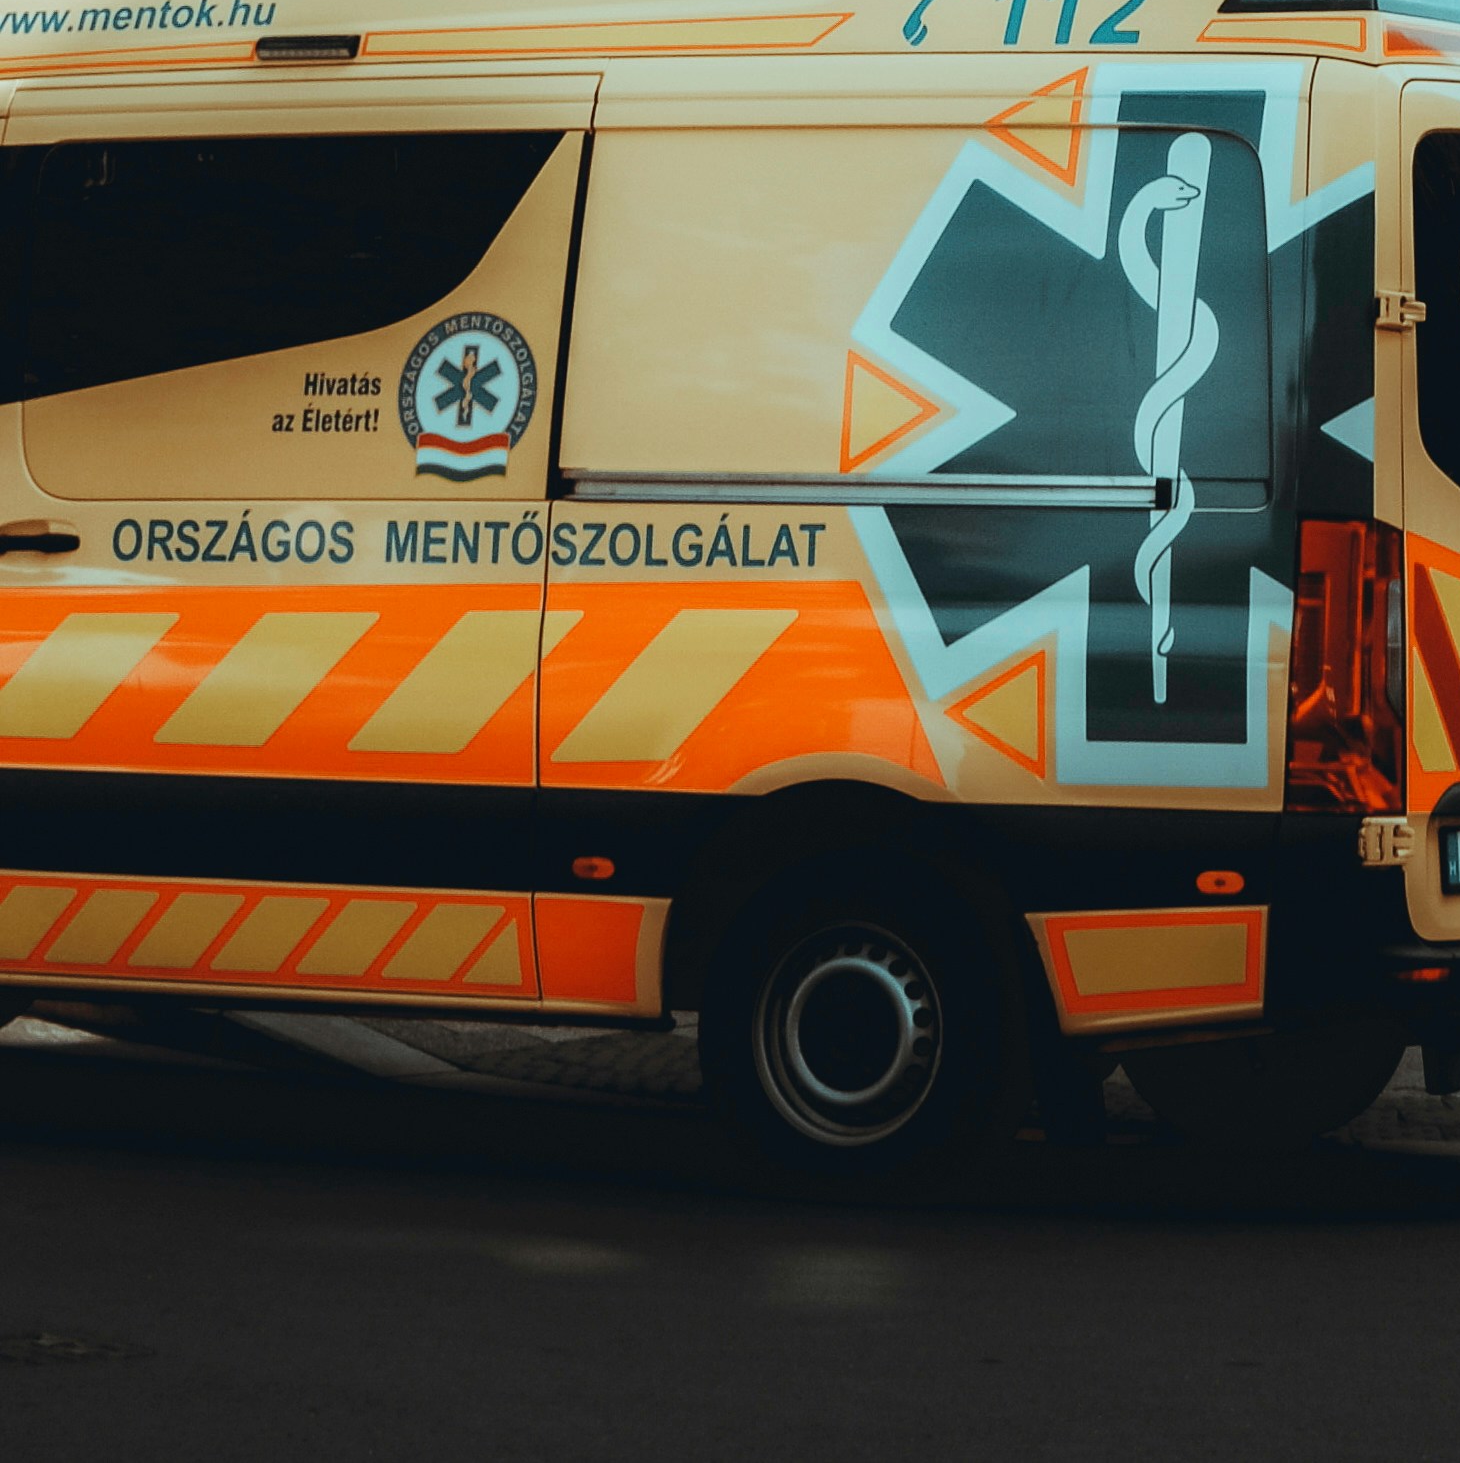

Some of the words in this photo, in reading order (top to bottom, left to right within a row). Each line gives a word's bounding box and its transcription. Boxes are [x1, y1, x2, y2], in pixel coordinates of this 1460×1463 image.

[303, 371, 382, 397] Hivatás
[271, 413, 295, 433] az
[301, 402, 380, 433] Életért!
[112, 508, 355, 564] ORSZÁGOS
[384, 510, 827, 568] MENTŐSZOLGÁLAT
